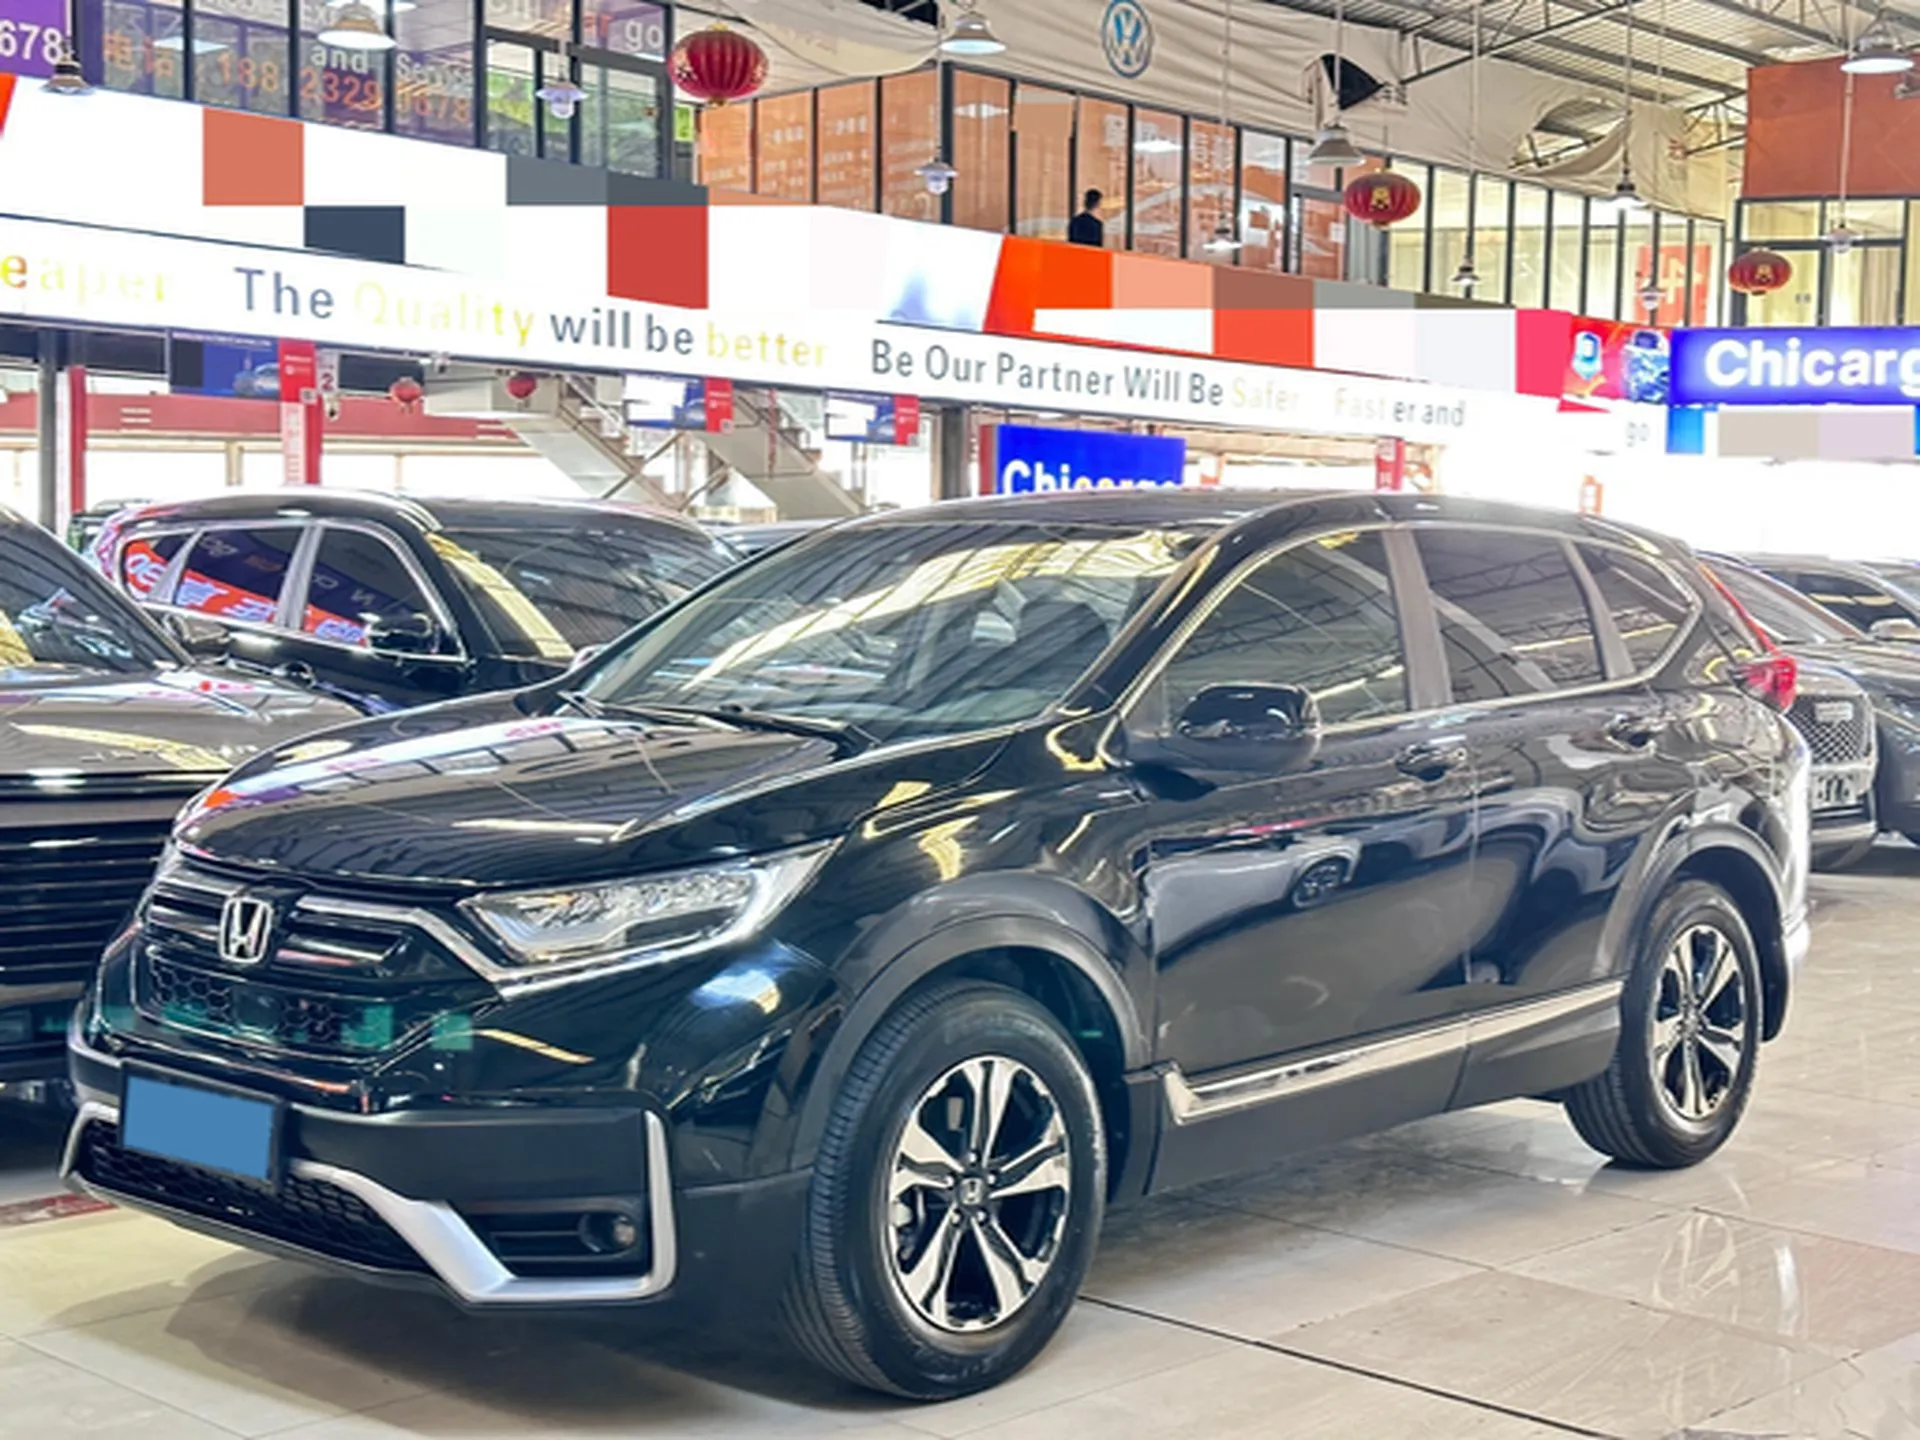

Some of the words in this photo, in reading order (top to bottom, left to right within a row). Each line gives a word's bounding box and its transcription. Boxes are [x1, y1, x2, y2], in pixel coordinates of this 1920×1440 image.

[0, 20, 63, 65] 678
[311, 45, 368, 74] and
[218, 52, 279, 92] 188
[234, 267, 334, 319] The
[355, 281, 534, 347] Quality
[551, 309, 631, 350] will
[645, 314, 693, 354] be
[707, 321, 826, 367] better
[872, 339, 913, 378] Be
[926, 345, 986, 383] Our
[998, 353, 1114, 396] Partner
[1124, 366, 1180, 402] Will
[1188, 374, 1223, 405] Be
[1232, 378, 1298, 413] Safer
[1421, 400, 1466, 427] and
